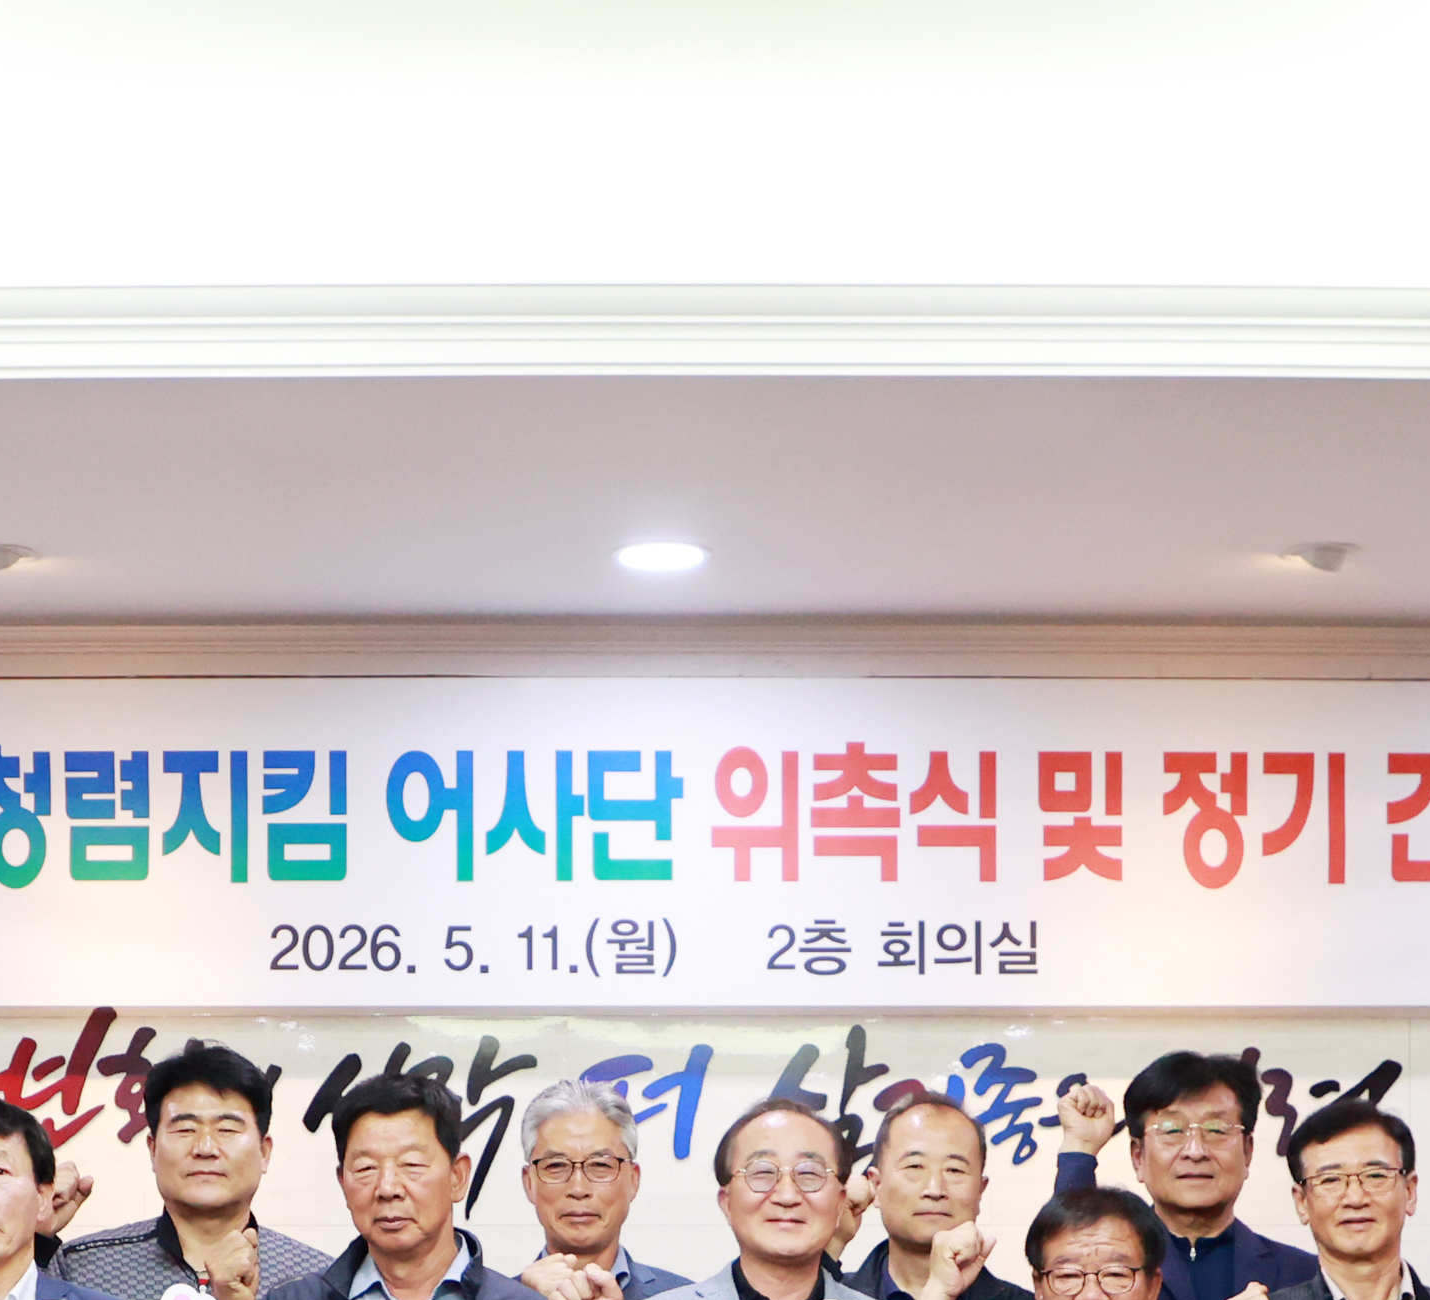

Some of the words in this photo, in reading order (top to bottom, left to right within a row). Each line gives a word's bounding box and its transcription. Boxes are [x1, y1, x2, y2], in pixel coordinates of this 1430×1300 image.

[386, 749, 685, 883] 어사단
[711, 742, 998, 883] 위촉식
[1038, 751, 1124, 883] 및
[1163, 751, 1347, 889] 정기
[269, 925, 417, 975] 2026.
[444, 926, 490, 974] 5.
[518, 917, 678, 977] 11.(월)
[767, 920, 852, 977] 2층
[877, 920, 1039, 977] 회의실
